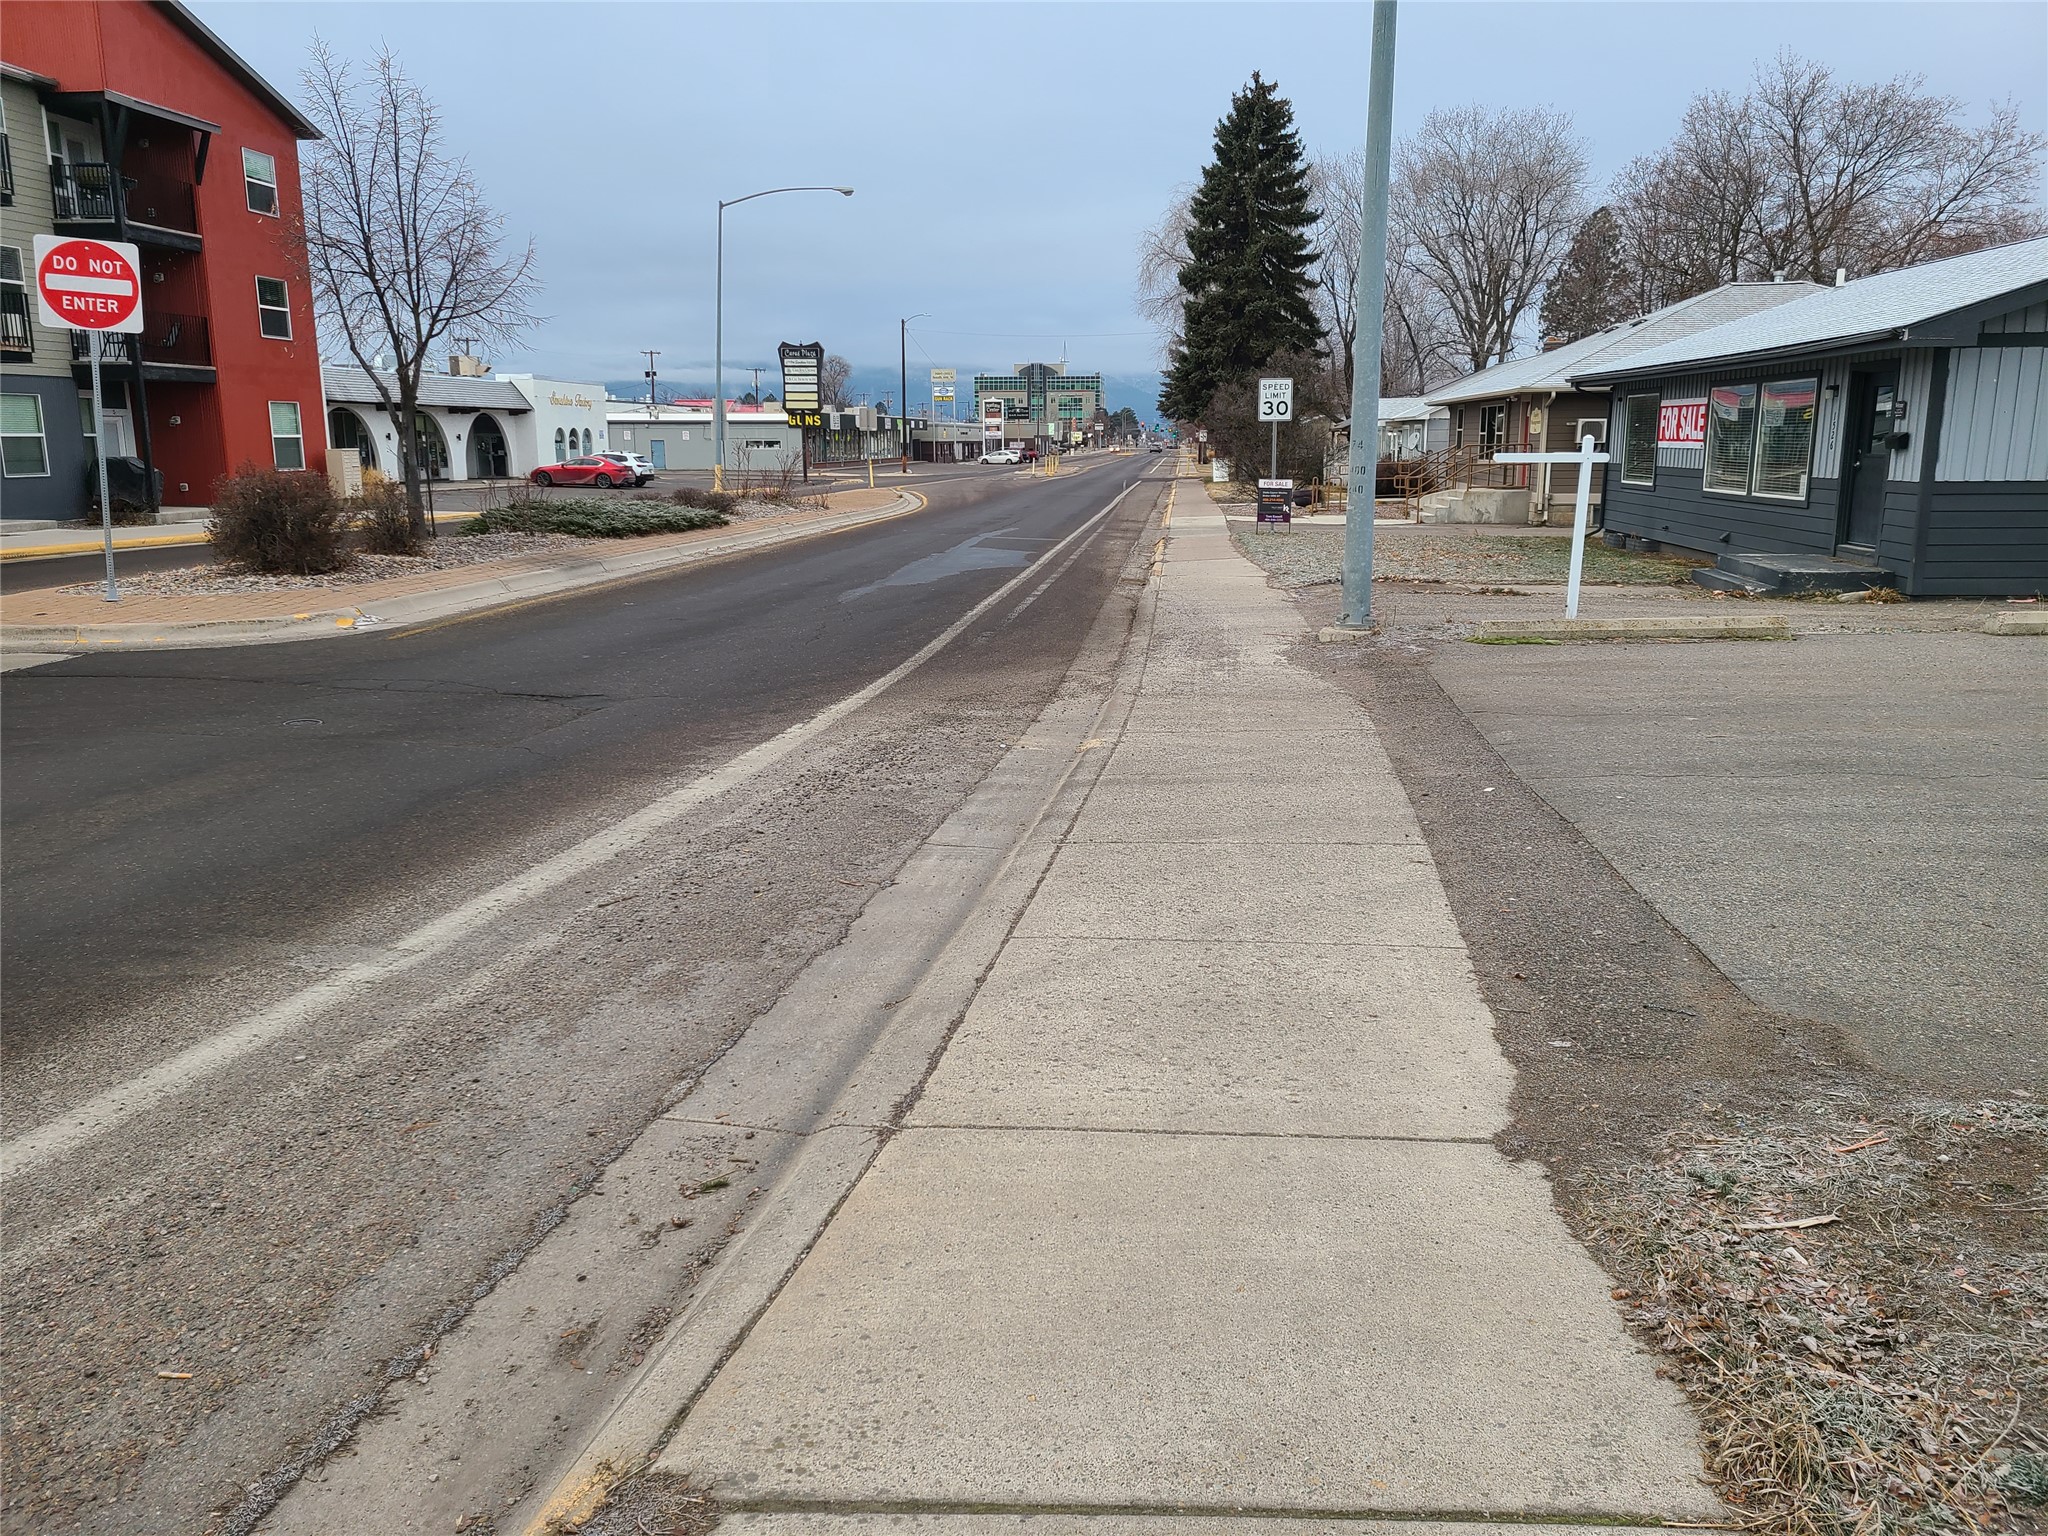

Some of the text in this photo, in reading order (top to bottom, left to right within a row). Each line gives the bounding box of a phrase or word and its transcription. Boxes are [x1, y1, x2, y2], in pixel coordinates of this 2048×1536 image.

[52, 255, 123, 275] DO NOT
[62, 295, 119, 314] ENTER
[1262, 383, 1290, 391] SPEED
[1262, 400, 1289, 416] 30
[788, 415, 822, 426] GUNS
[1660, 405, 1706, 440] FOR SALE
